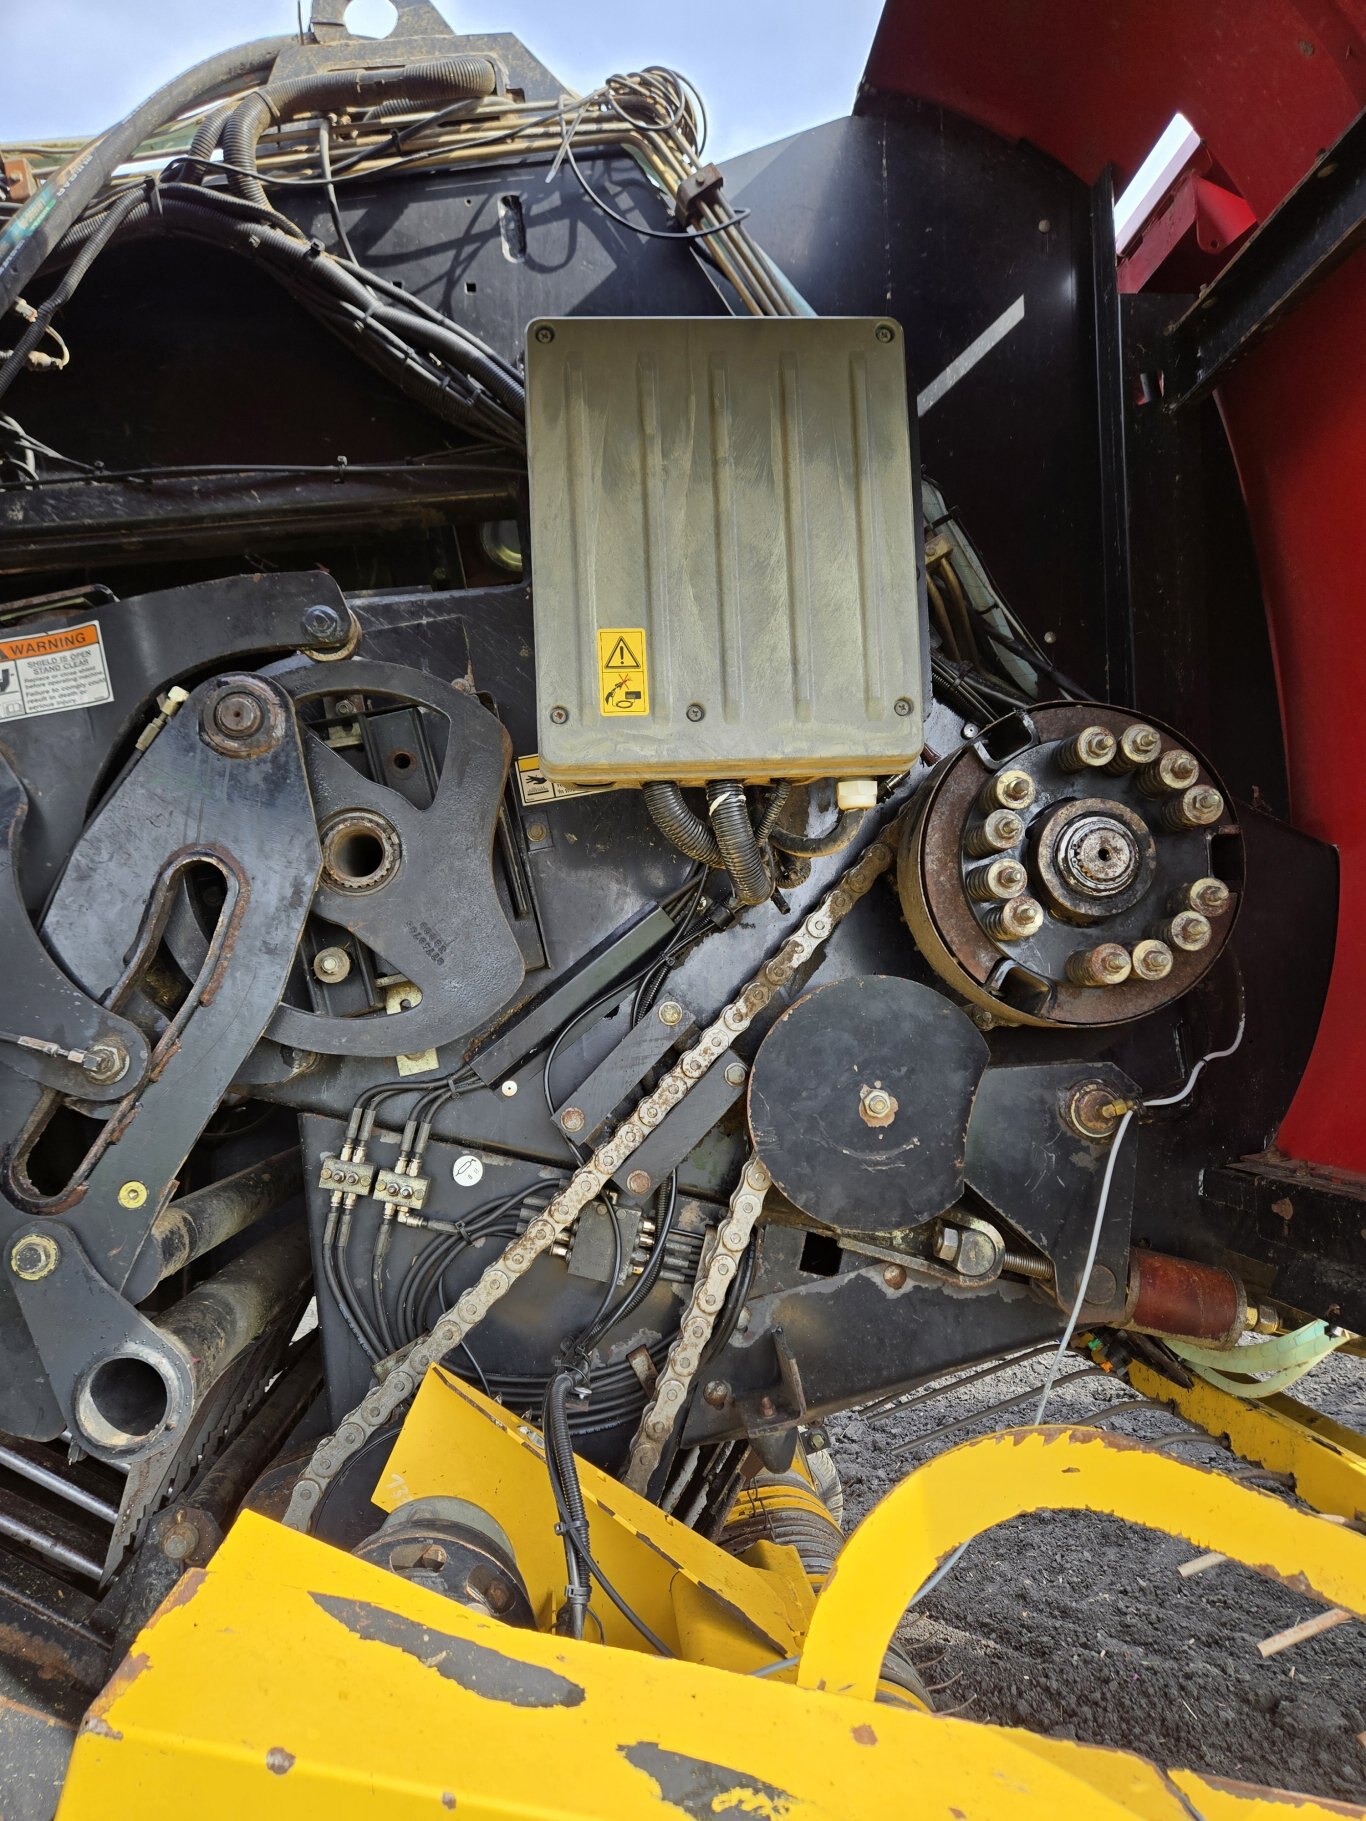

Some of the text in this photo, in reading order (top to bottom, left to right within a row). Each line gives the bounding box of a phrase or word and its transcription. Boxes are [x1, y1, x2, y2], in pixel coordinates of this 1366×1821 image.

[10, 632, 86, 656] WARNING
[27, 657, 57, 669] SHIELD
[70, 650, 91, 660] OPEN
[33, 658, 89, 675] STAND CLEAR
[26, 689, 50, 698] Failure
